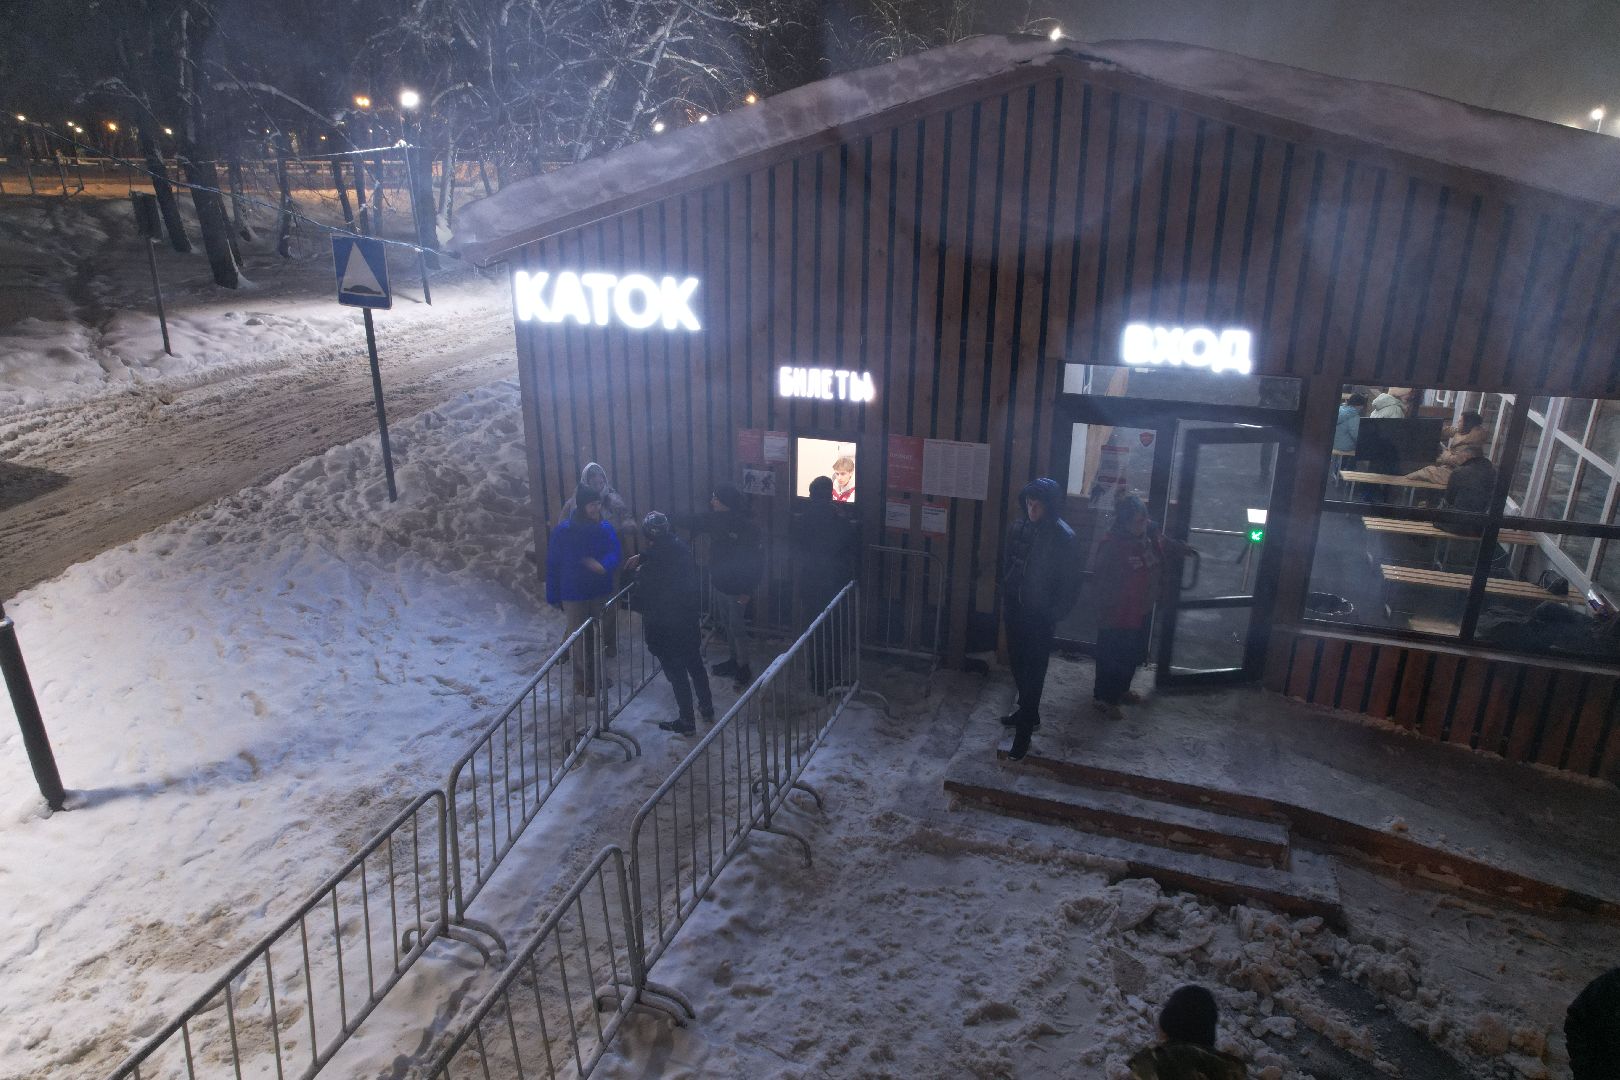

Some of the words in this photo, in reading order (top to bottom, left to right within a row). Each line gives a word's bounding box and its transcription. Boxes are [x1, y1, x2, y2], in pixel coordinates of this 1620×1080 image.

[515, 270, 702, 331] КАТОК
[1122, 323, 1253, 374] ВХОД
[778, 366, 876, 402] БИЛЕТЫ
